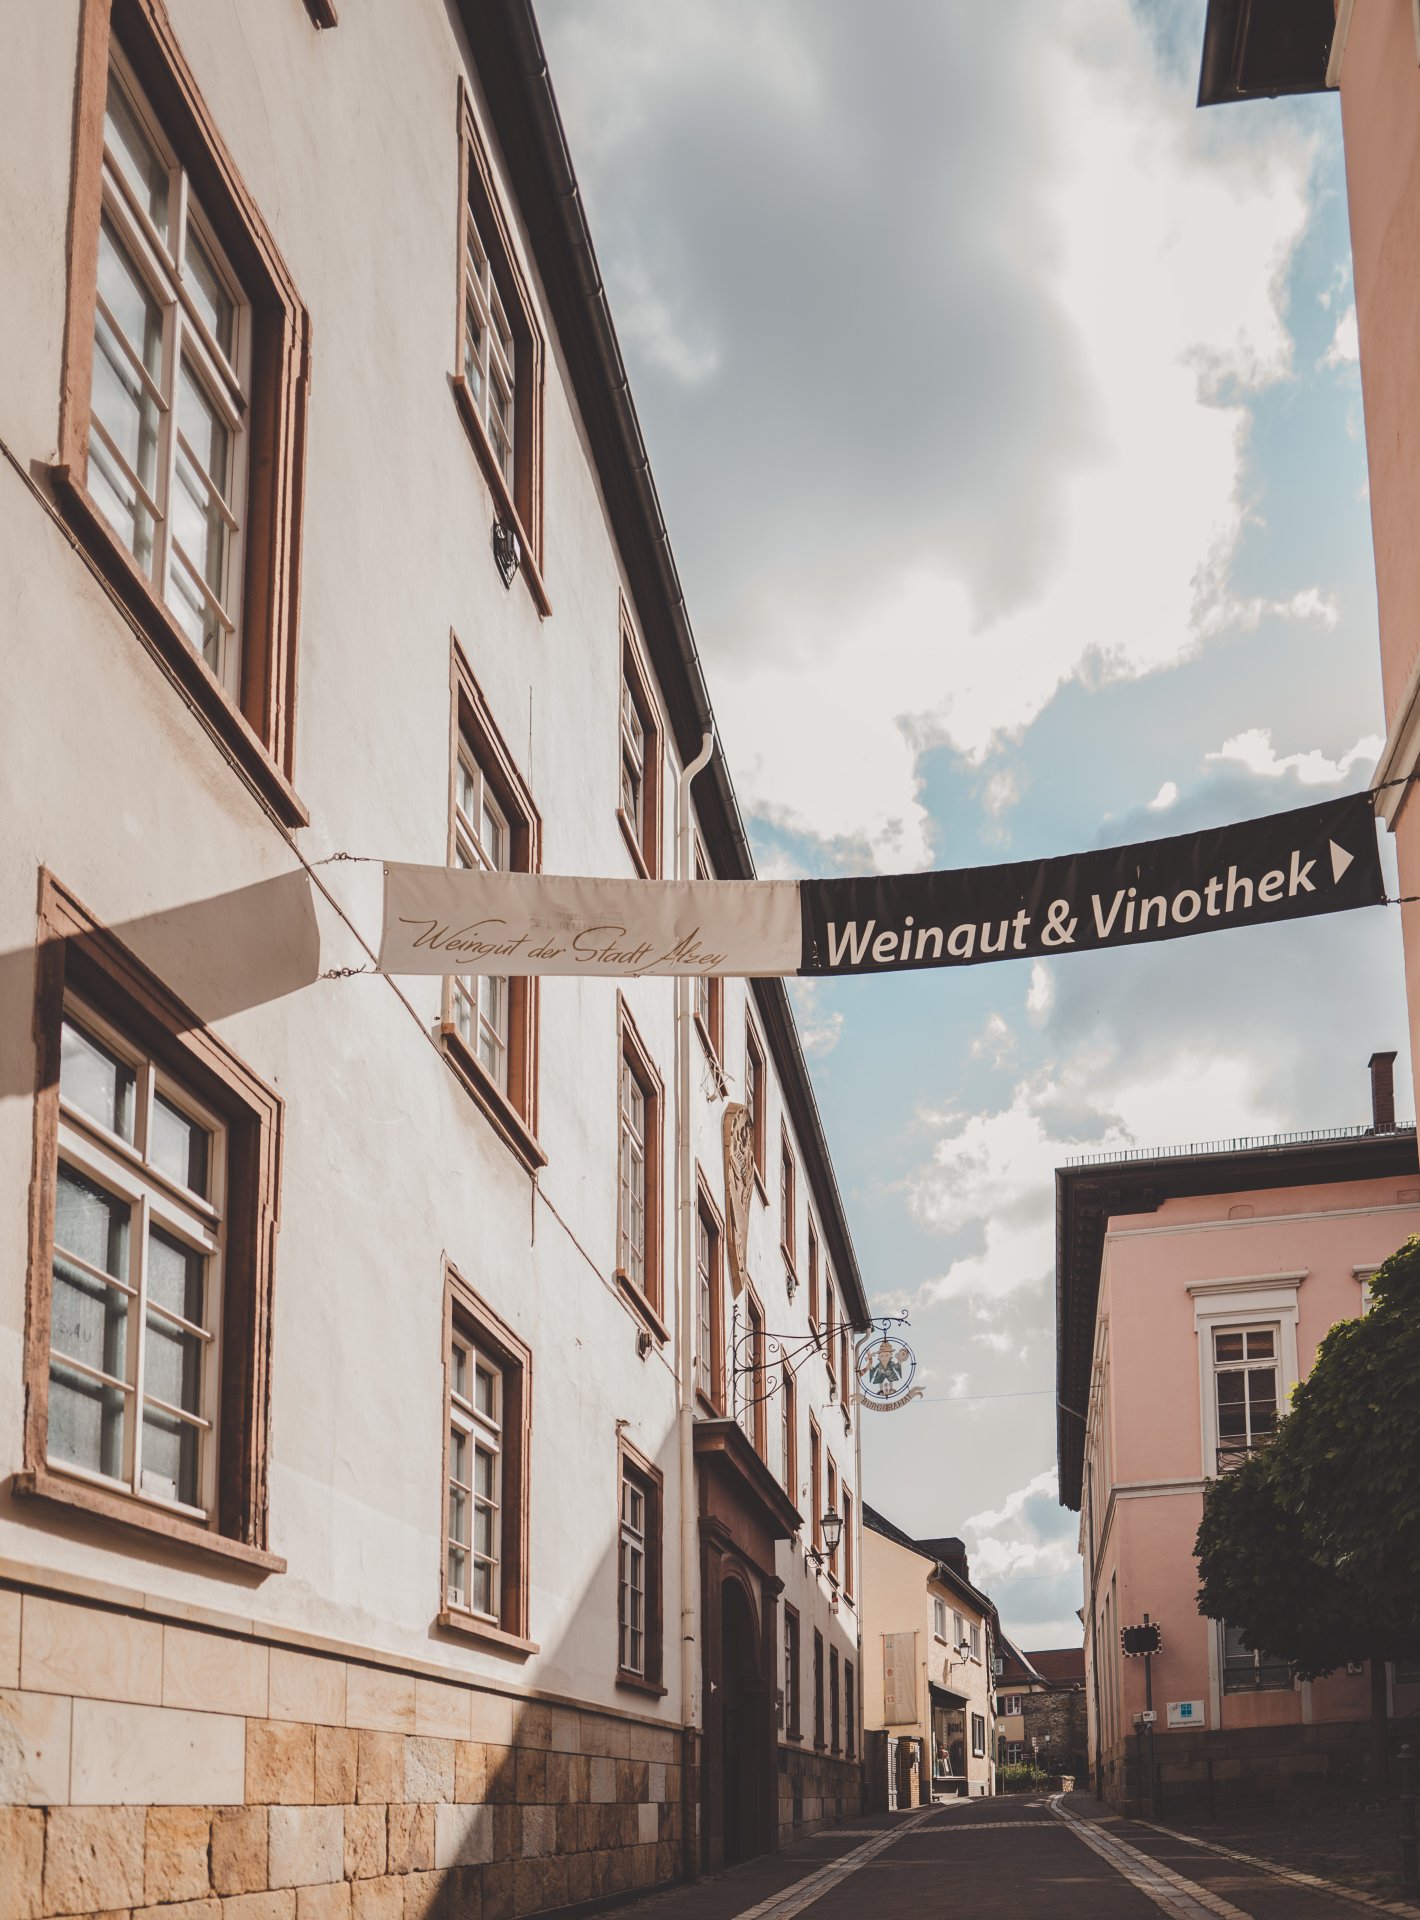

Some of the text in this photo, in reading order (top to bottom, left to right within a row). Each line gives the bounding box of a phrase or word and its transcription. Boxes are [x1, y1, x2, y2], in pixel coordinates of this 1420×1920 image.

[1041, 899, 1078, 946] &
[1092, 850, 1317, 938] Vinothek
[399, 917, 532, 963] Weingut
[528, 937, 566, 959] der
[573, 926, 655, 963] Stadt
[624, 927, 728, 973] Alzey
